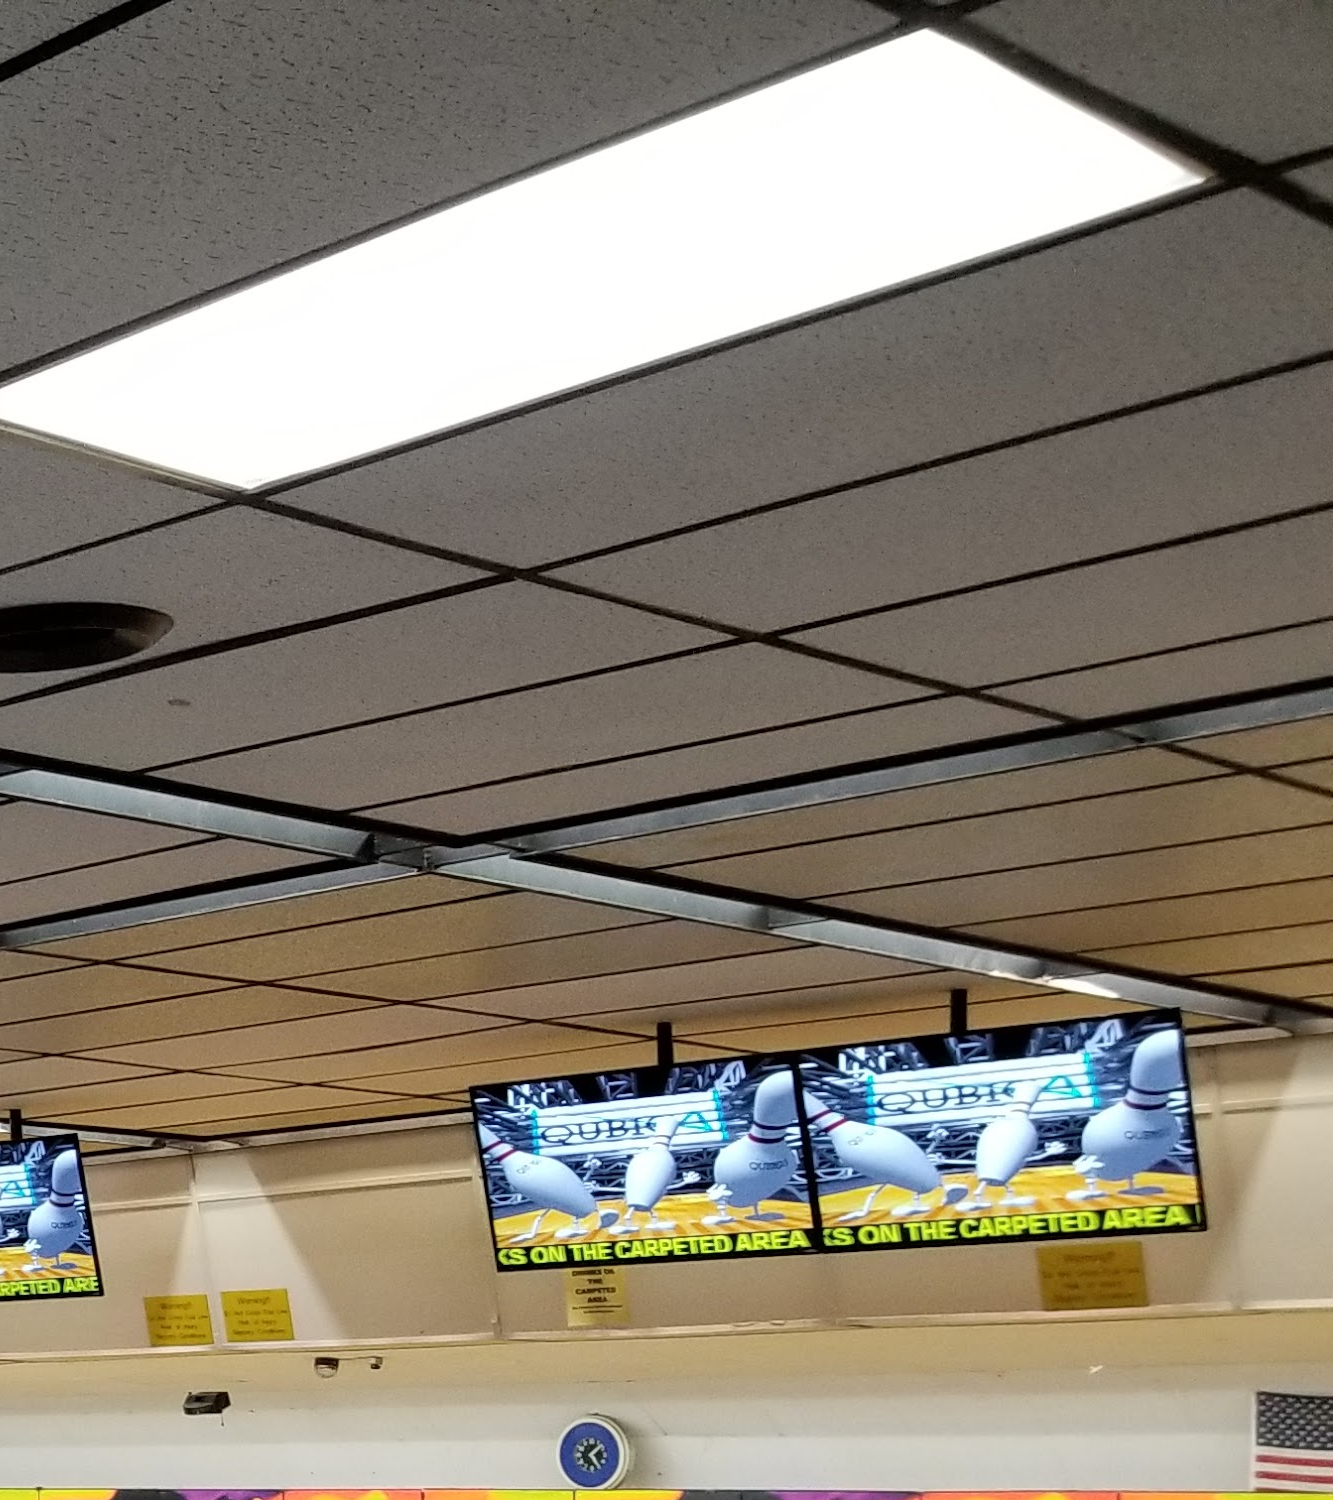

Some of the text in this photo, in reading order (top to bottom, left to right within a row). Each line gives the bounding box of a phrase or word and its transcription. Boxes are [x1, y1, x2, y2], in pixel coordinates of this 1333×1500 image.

[858, 1225, 903, 1243] ON
[904, 1220, 956, 1241] THE
[958, 1211, 1099, 1237] CARPETED
[1102, 1205, 1191, 1229] AREA
[530, 1246, 566, 1265] ON
[569, 1243, 614, 1261] THE
[615, 1235, 733, 1259] CARPETED
[735, 1231, 812, 1251] AREA
